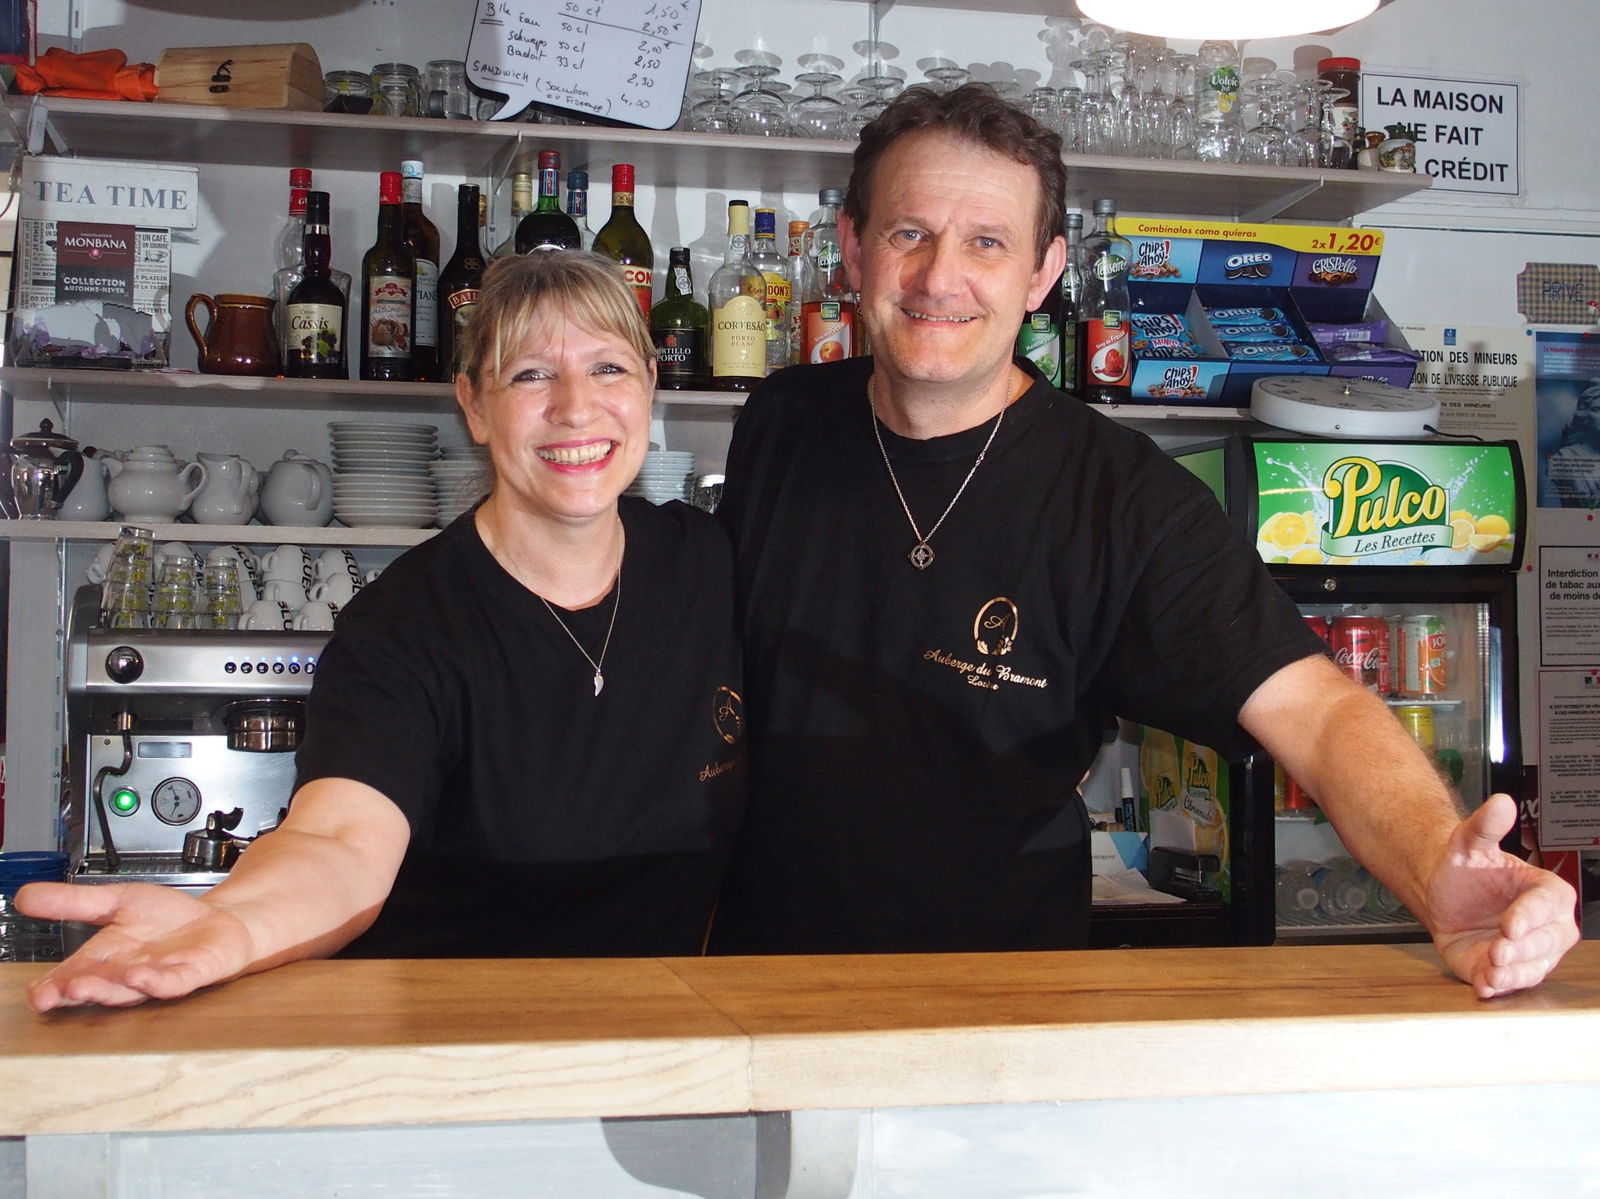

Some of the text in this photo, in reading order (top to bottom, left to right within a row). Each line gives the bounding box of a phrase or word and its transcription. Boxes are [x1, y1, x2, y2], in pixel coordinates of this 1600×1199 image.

[565, 2, 579, 12] 50
[561, 22, 572, 31] 50
[559, 41, 570, 50] 50
[634, 56, 661, 69] 2,50
[556, 56, 569, 67] 33
[627, 74, 654, 88] 2,30
[1377, 87, 1503, 114] LA MAISON
[1435, 125, 1484, 146] FAIT
[1425, 157, 1509, 182] CRÉDIT
[33, 181, 188, 211] TEA TIME
[1138, 224, 1193, 235] Combinalos
[1223, 229, 1257, 238] quieras
[64, 237, 127, 250] MONBANA
[1139, 241, 1165, 256] Chips
[1227, 253, 1272, 268] OREO
[63, 277, 126, 288] COLLECTION
[624, 271, 652, 284] CON
[1542, 279, 1585, 302] PRIVÉ
[291, 315, 329, 331] Cassis
[718, 321, 766, 331] CORTESÃO
[656, 354, 686, 362] PORTO
[1449, 351, 1469, 363] DES
[1474, 353, 1518, 365] MINEURS
[1165, 367, 1192, 380] Chips
[1431, 373, 1441, 385] DE
[1482, 375, 1518, 388] PUBLIQUE
[1322, 456, 1447, 540] Pulco
[1354, 531, 1436, 554] Les Recettes
[1547, 569, 1599, 578] Interdiction
[1546, 581, 1557, 589] de
[1559, 581, 1584, 589] tabac
[1550, 592, 1561, 600] de
[1563, 592, 1590, 600] moins
[924, 649, 1048, 689] Auberge du Bramont
